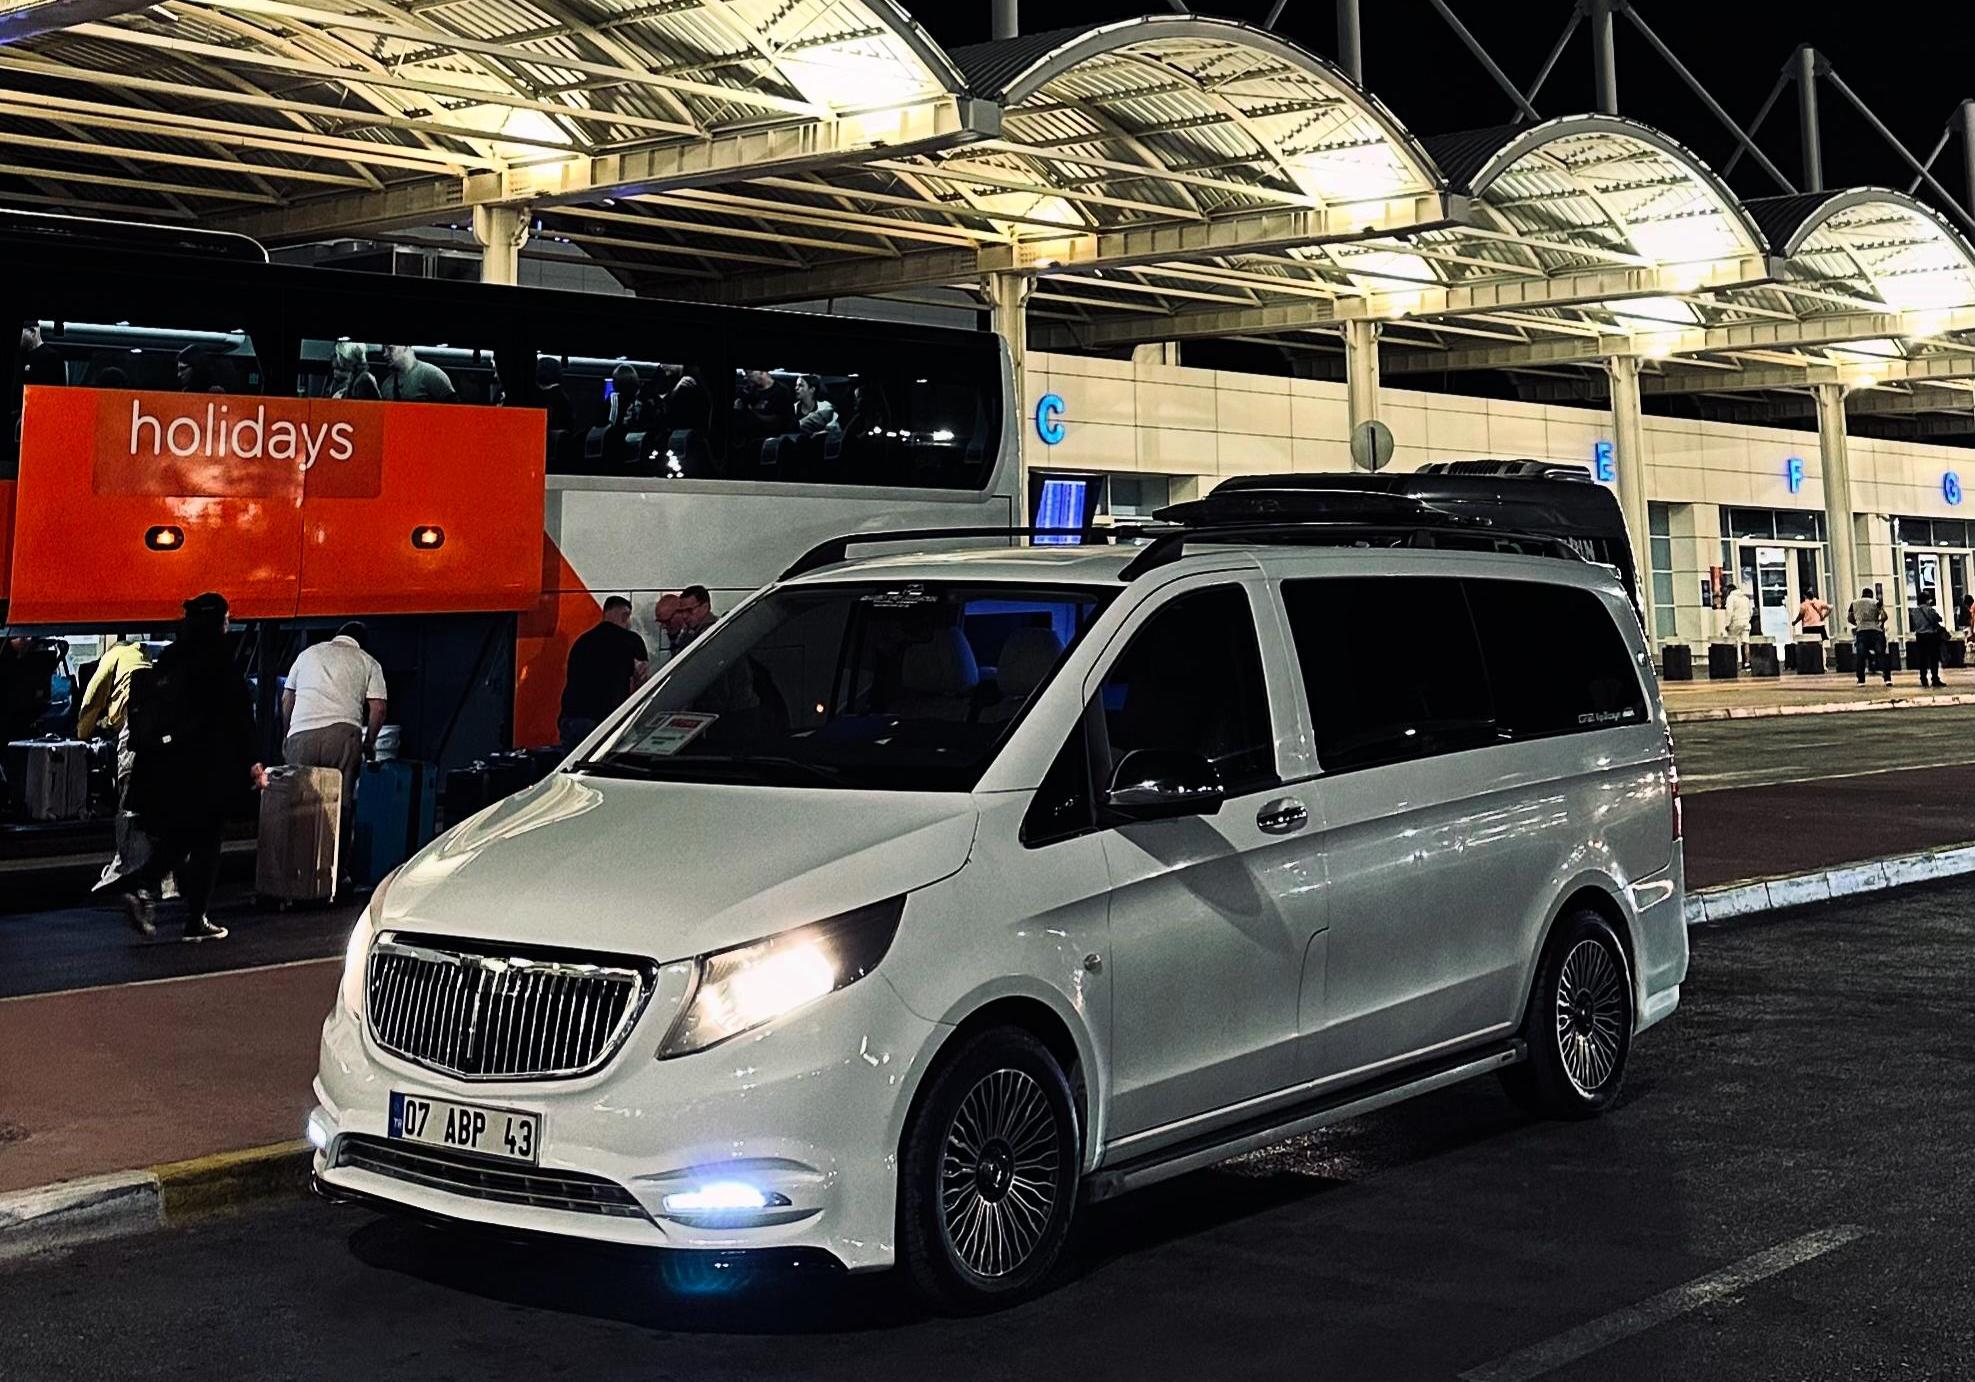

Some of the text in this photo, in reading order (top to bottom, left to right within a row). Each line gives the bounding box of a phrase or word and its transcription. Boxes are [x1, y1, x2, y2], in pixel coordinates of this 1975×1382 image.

[130, 400, 354, 471] holidays
[1036, 394, 1065, 445] C
[1595, 442, 1615, 481] E
[1787, 458, 1803, 494] F
[1943, 471, 1961, 505] G
[393, 1117, 402, 1129] TR
[405, 1100, 532, 1157] 07 ABP 43
